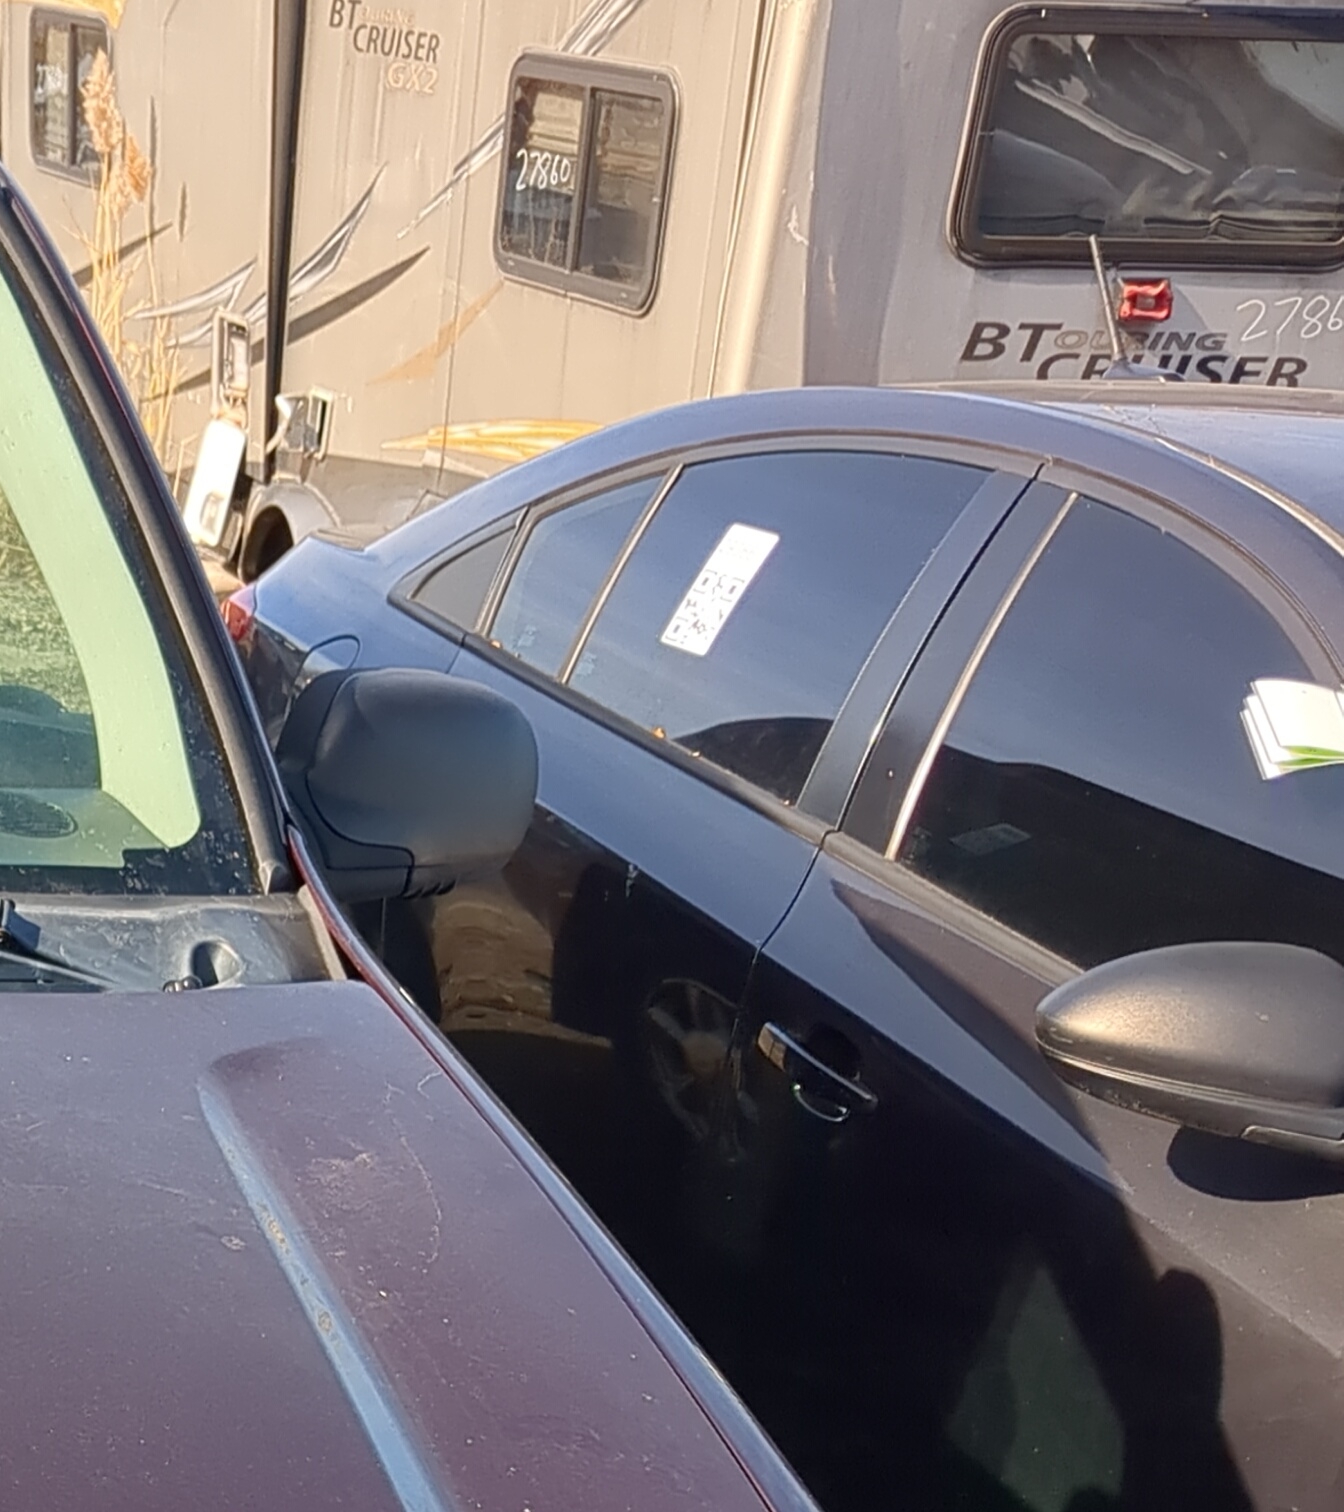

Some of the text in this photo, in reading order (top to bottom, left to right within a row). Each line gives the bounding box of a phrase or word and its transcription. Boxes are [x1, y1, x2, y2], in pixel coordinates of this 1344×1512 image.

[353, 24, 440, 64] CRUISER
[387, 61, 438, 95] GX2
[515, 148, 571, 191] 27860
[1236, 295, 1344, 342] 2786
